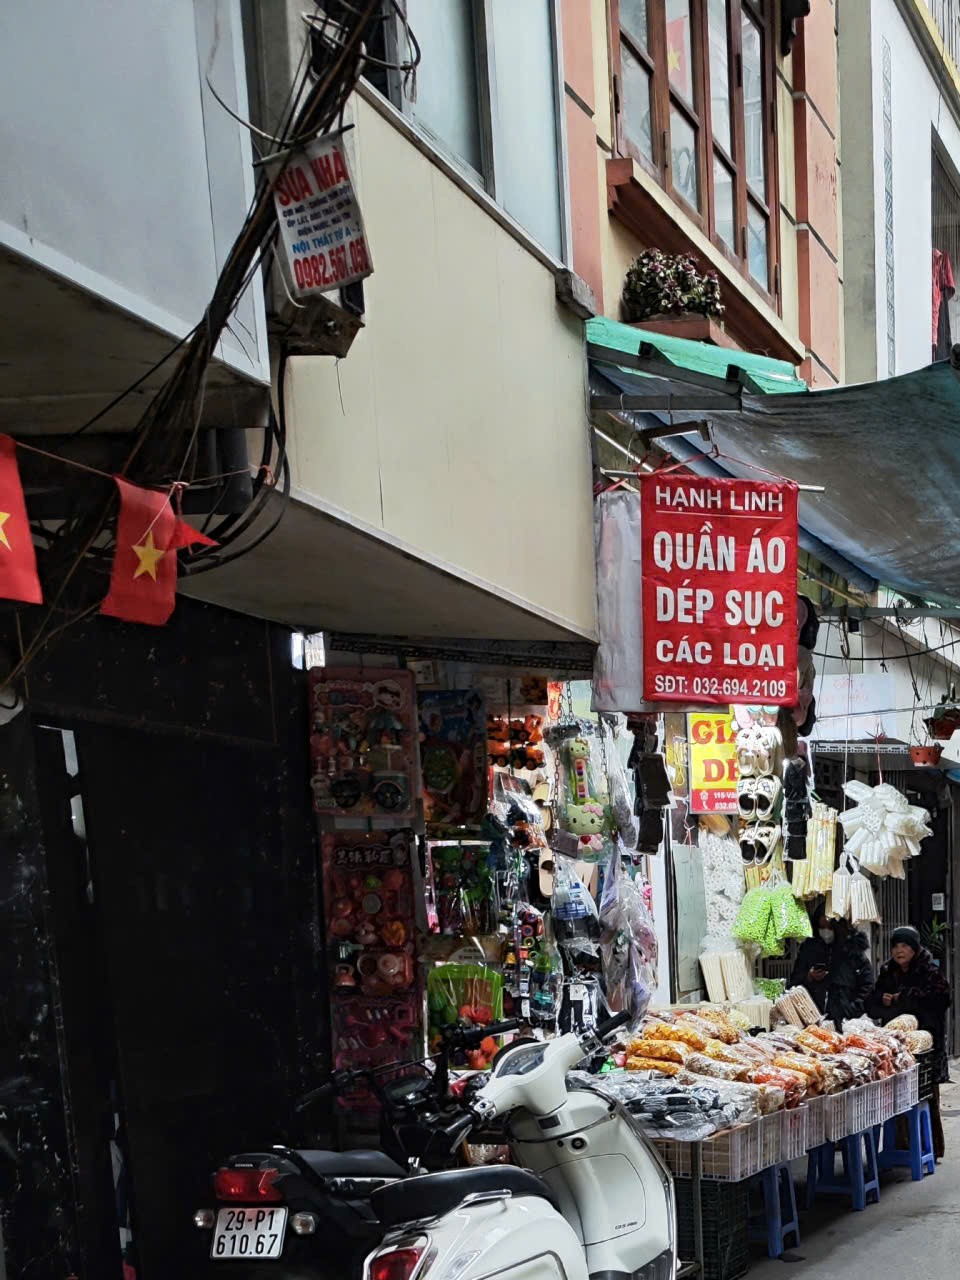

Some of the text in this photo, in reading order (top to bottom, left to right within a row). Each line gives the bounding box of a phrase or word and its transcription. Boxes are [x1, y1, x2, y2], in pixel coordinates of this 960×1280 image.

[311, 146, 349, 192] NHÀ
[655, 485, 783, 512] HẠNH LINH
[653, 521, 786, 574] QUẦN ÁO
[656, 579, 784, 635] DÉP SỤC
[656, 635, 784, 671] CÁC LOẠI
[655, 674, 786, 697] SĐT: 032.694.2109
[225, 1210, 275, 1231] 29-P1
[216, 1234, 278, 1255] 610.67
